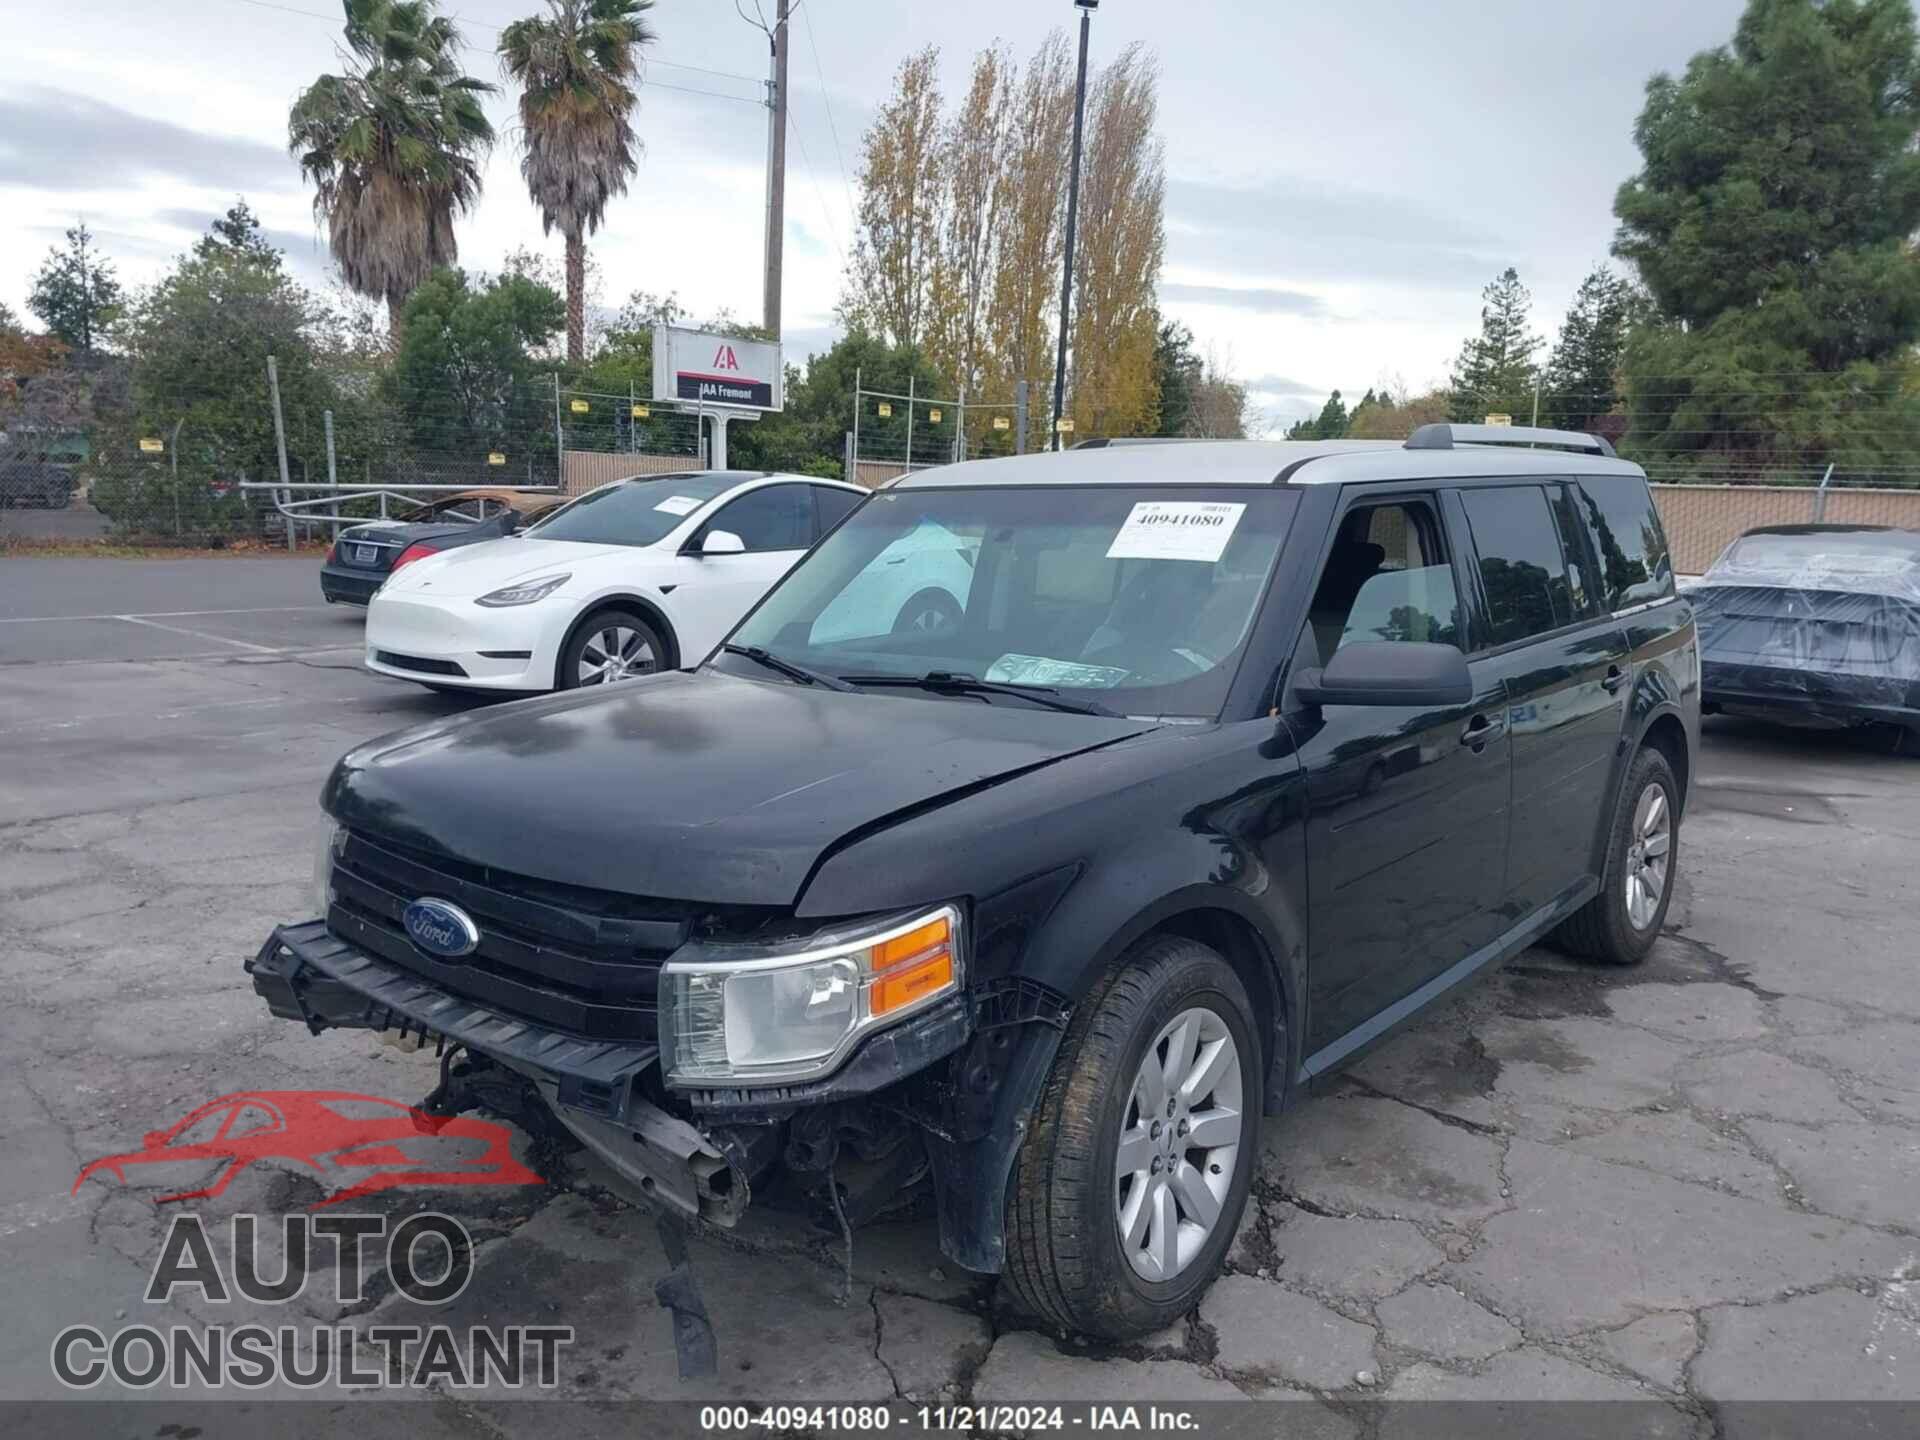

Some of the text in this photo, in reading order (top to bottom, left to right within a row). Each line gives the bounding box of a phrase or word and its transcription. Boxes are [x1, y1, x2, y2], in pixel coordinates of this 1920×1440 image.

[699, 382, 752, 400] IAA Fremont
[1137, 513, 1225, 528] 40941080
[412, 906, 453, 946] Ford
